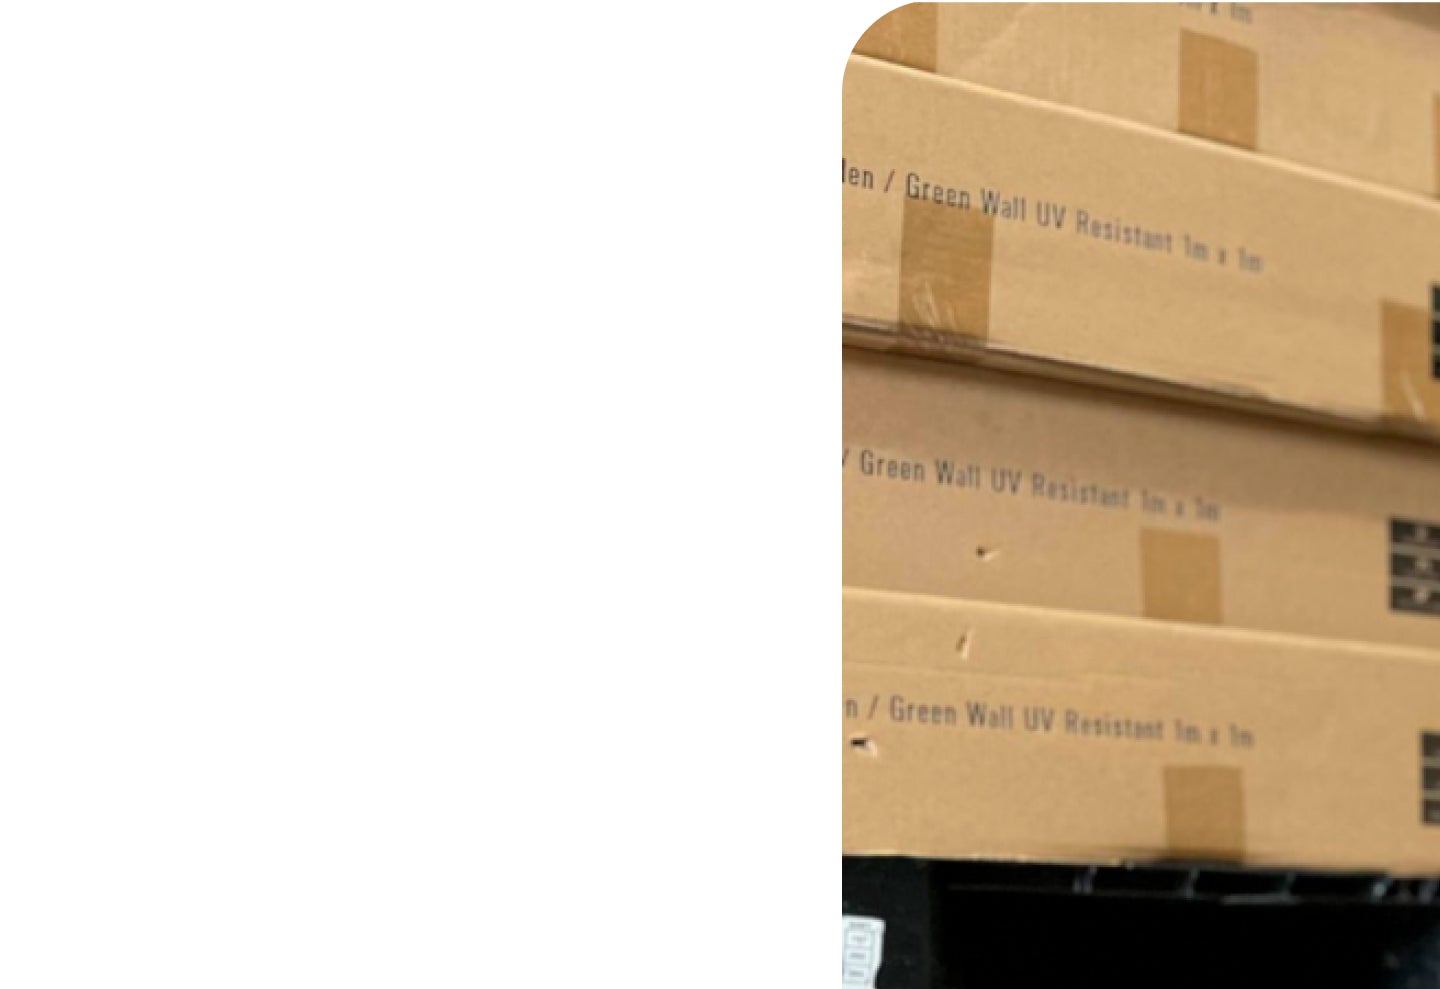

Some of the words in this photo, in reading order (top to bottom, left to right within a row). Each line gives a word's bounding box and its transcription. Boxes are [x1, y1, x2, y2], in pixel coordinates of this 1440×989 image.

[905, 172, 971, 211] Green
[980, 186, 1027, 222] Wall
[1036, 201, 1067, 229] UV
[1076, 208, 1172, 255] Resistant
[1184, 233, 1208, 261] 1m
[860, 449, 926, 482] Green
[934, 458, 981, 490] Wall
[991, 467, 1022, 496] UV
[1032, 471, 1129, 509] Resistant
[890, 694, 957, 726] Green
[966, 699, 1013, 729] Wall
[1023, 705, 1055, 732] UV
[1065, 708, 1163, 741] Resistant
